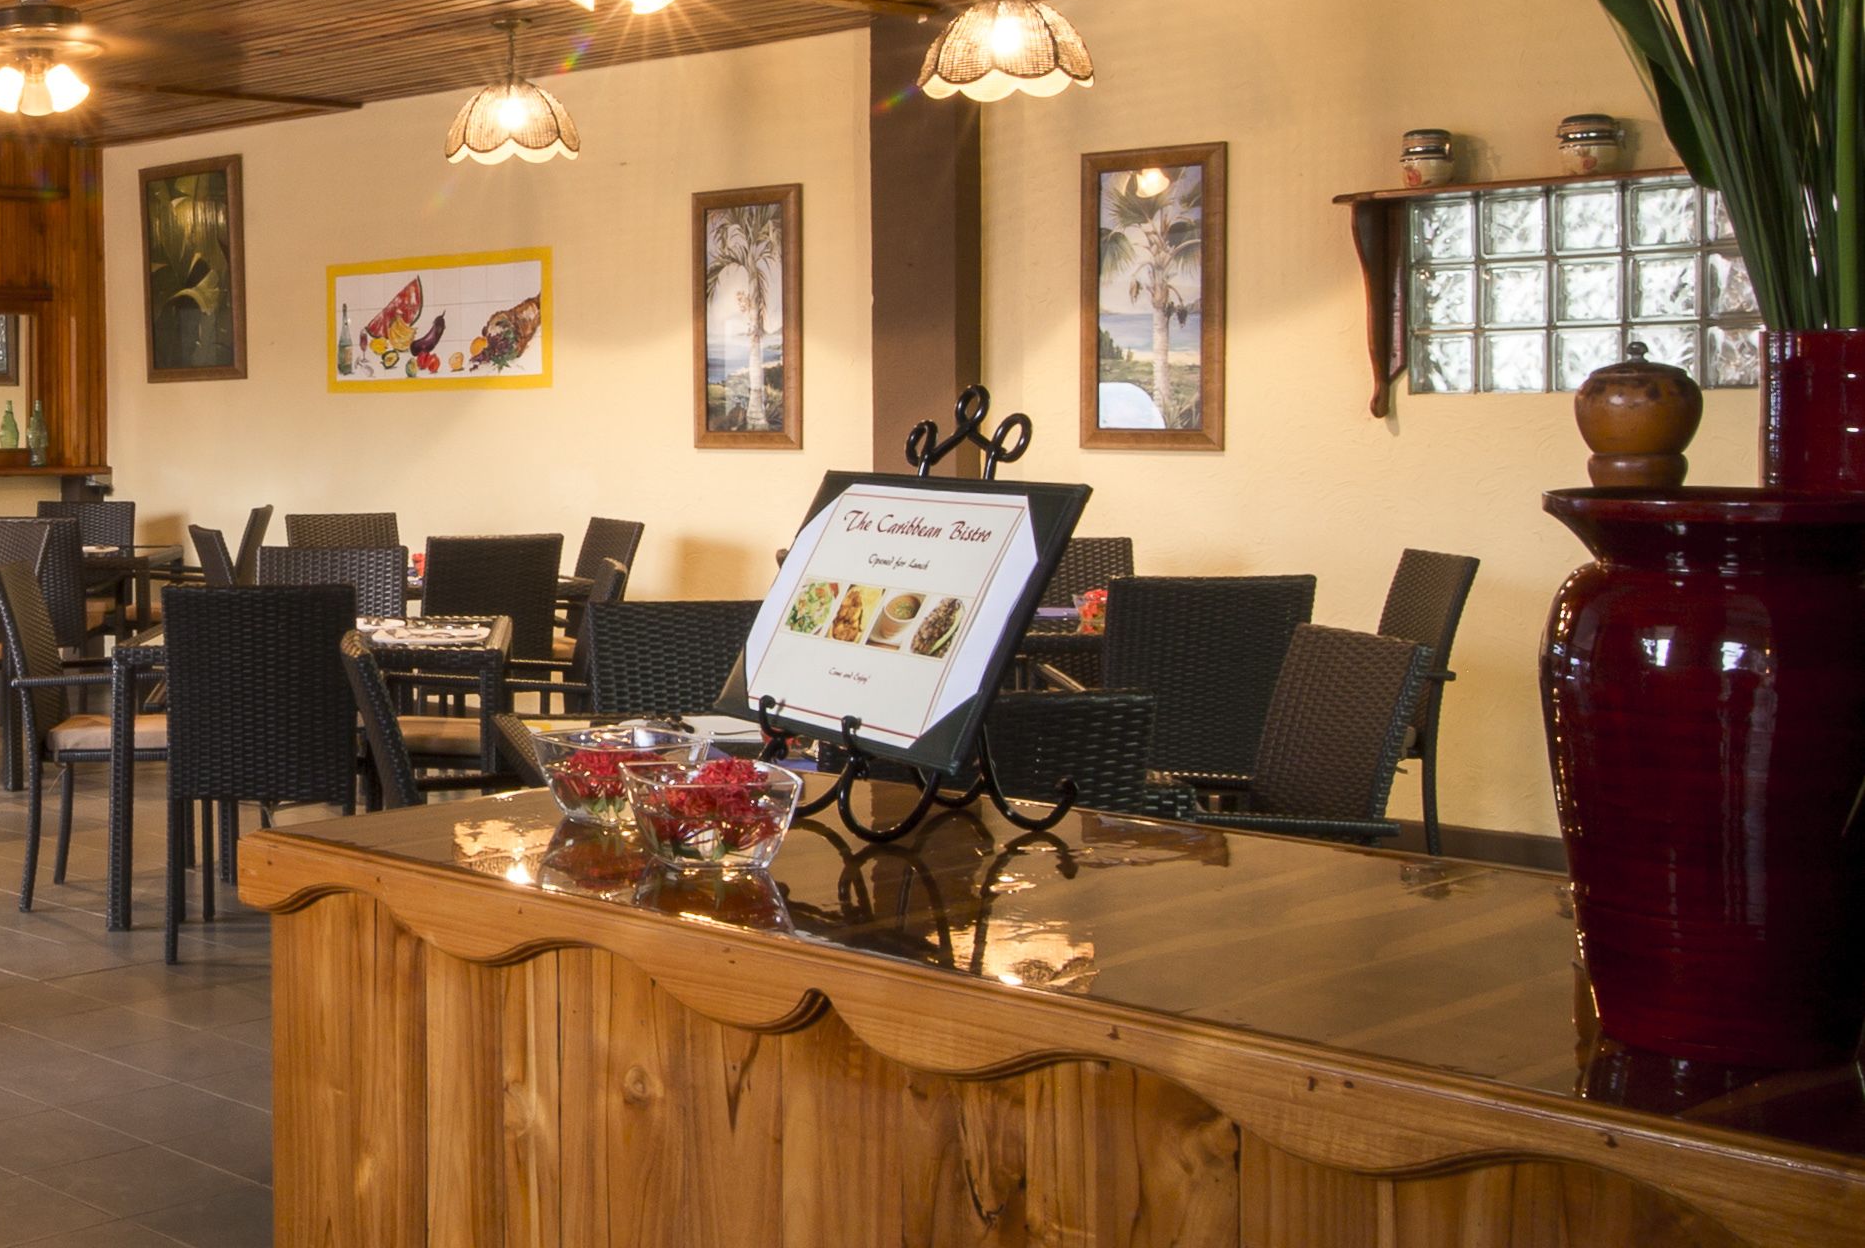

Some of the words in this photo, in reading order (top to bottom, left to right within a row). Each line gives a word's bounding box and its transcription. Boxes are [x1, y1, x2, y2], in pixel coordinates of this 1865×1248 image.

[843, 509, 873, 532] The
[877, 513, 943, 539] Caribbean
[949, 520, 993, 543] Bistro
[893, 556, 906, 570] for
[908, 560, 931, 571] Lunch
